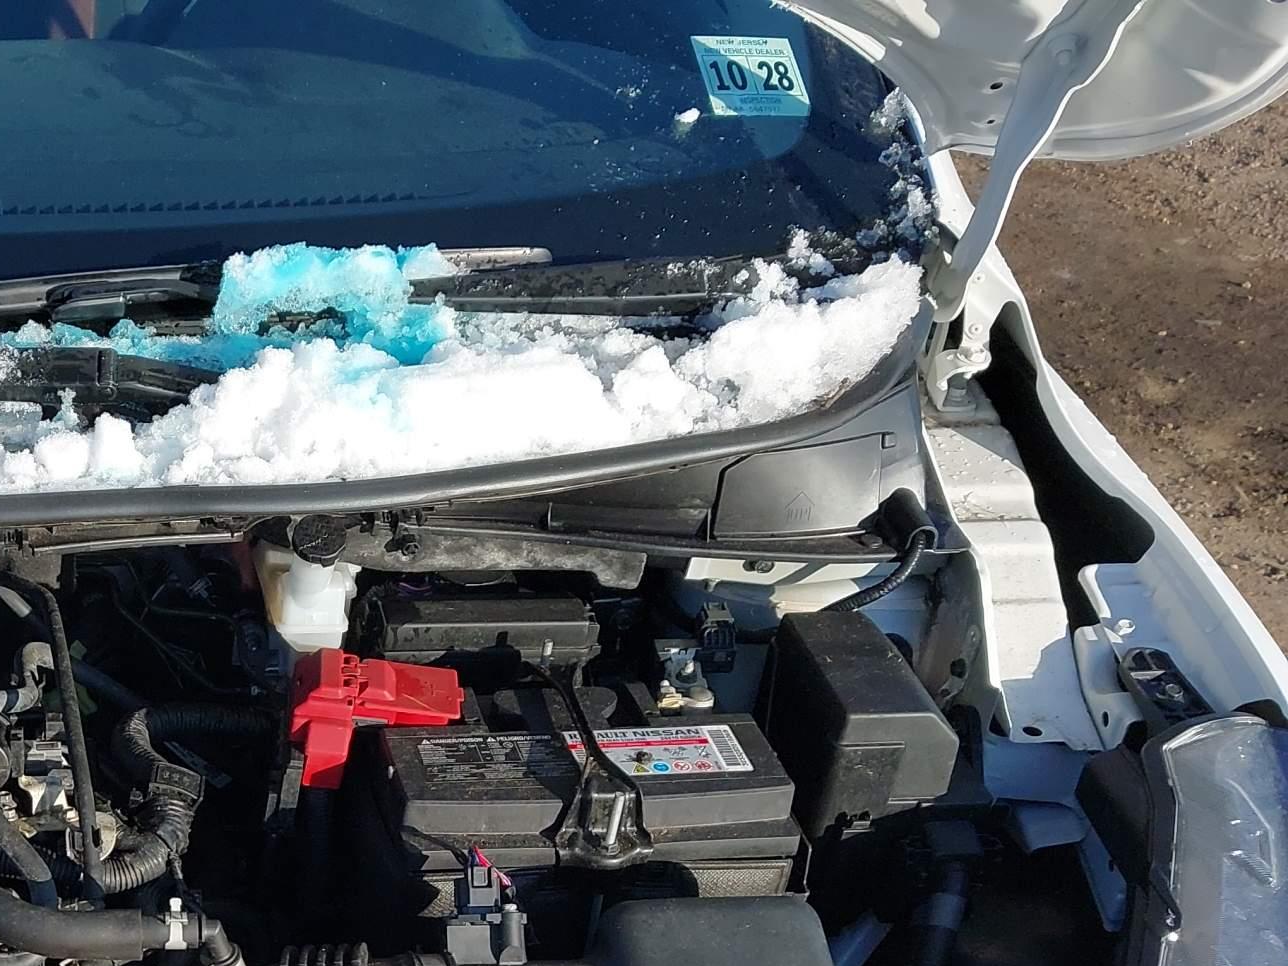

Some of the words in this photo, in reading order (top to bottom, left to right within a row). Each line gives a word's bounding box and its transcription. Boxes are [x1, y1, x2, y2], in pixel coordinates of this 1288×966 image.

[724, 47, 754, 55] VEHICLE
[755, 48, 786, 56] DEALER
[709, 60, 749, 91] 10
[757, 60, 795, 92] 28
[632, 728, 701, 738] NISSAN
